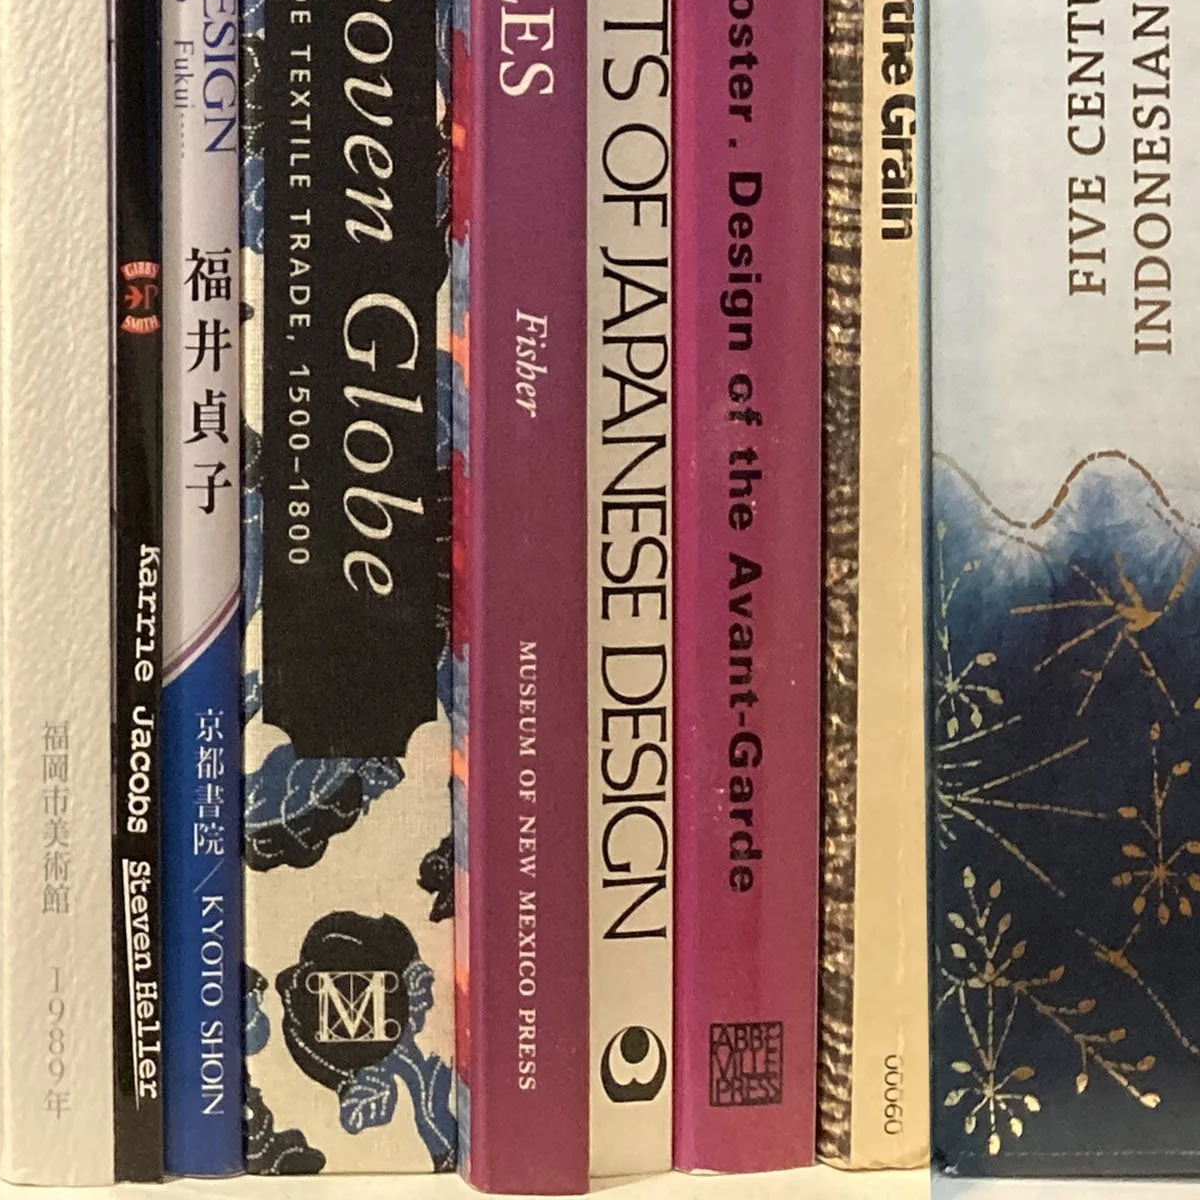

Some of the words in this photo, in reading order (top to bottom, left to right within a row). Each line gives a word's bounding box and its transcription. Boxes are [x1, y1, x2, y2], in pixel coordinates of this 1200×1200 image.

[173, 40, 195, 109] Fukui
[289, 44, 312, 188] TEXTILE
[601, 123, 670, 228] OF
[880, 93, 917, 241] Grain
[1132, 2, 1172, 355] INDONESIAN
[286, 208, 311, 341] TRADE,
[719, 171, 763, 352] Design
[1068, 175, 1107, 297] FIVE
[183, 247, 232, 515] 福井貞子
[515, 308, 548, 418] Fisher
[727, 372, 763, 427] of
[342, 292, 425, 596] Globe
[599, 246, 669, 621] JAPANESE
[728, 447, 763, 531] the
[134, 543, 161, 682] Karrie
[519, 641, 537, 756] MUSEUM
[728, 551, 763, 893] Avant-Garde
[41, 721, 71, 915] 福岡市美術館
[126, 705, 155, 833] Jacobs
[518, 768, 537, 804] OF
[600, 644, 669, 940] DESIGN
[518, 815, 537, 878] NEW
[129, 861, 152, 982] Steven
[200, 895, 224, 1007] KYOTO
[518, 890, 537, 997] MEXICO
[47, 966, 71, 1119] 1989年
[135, 978, 162, 1099] Heller
[200, 1020, 225, 1115] SHOIN
[518, 1008, 537, 1090] PRESS
